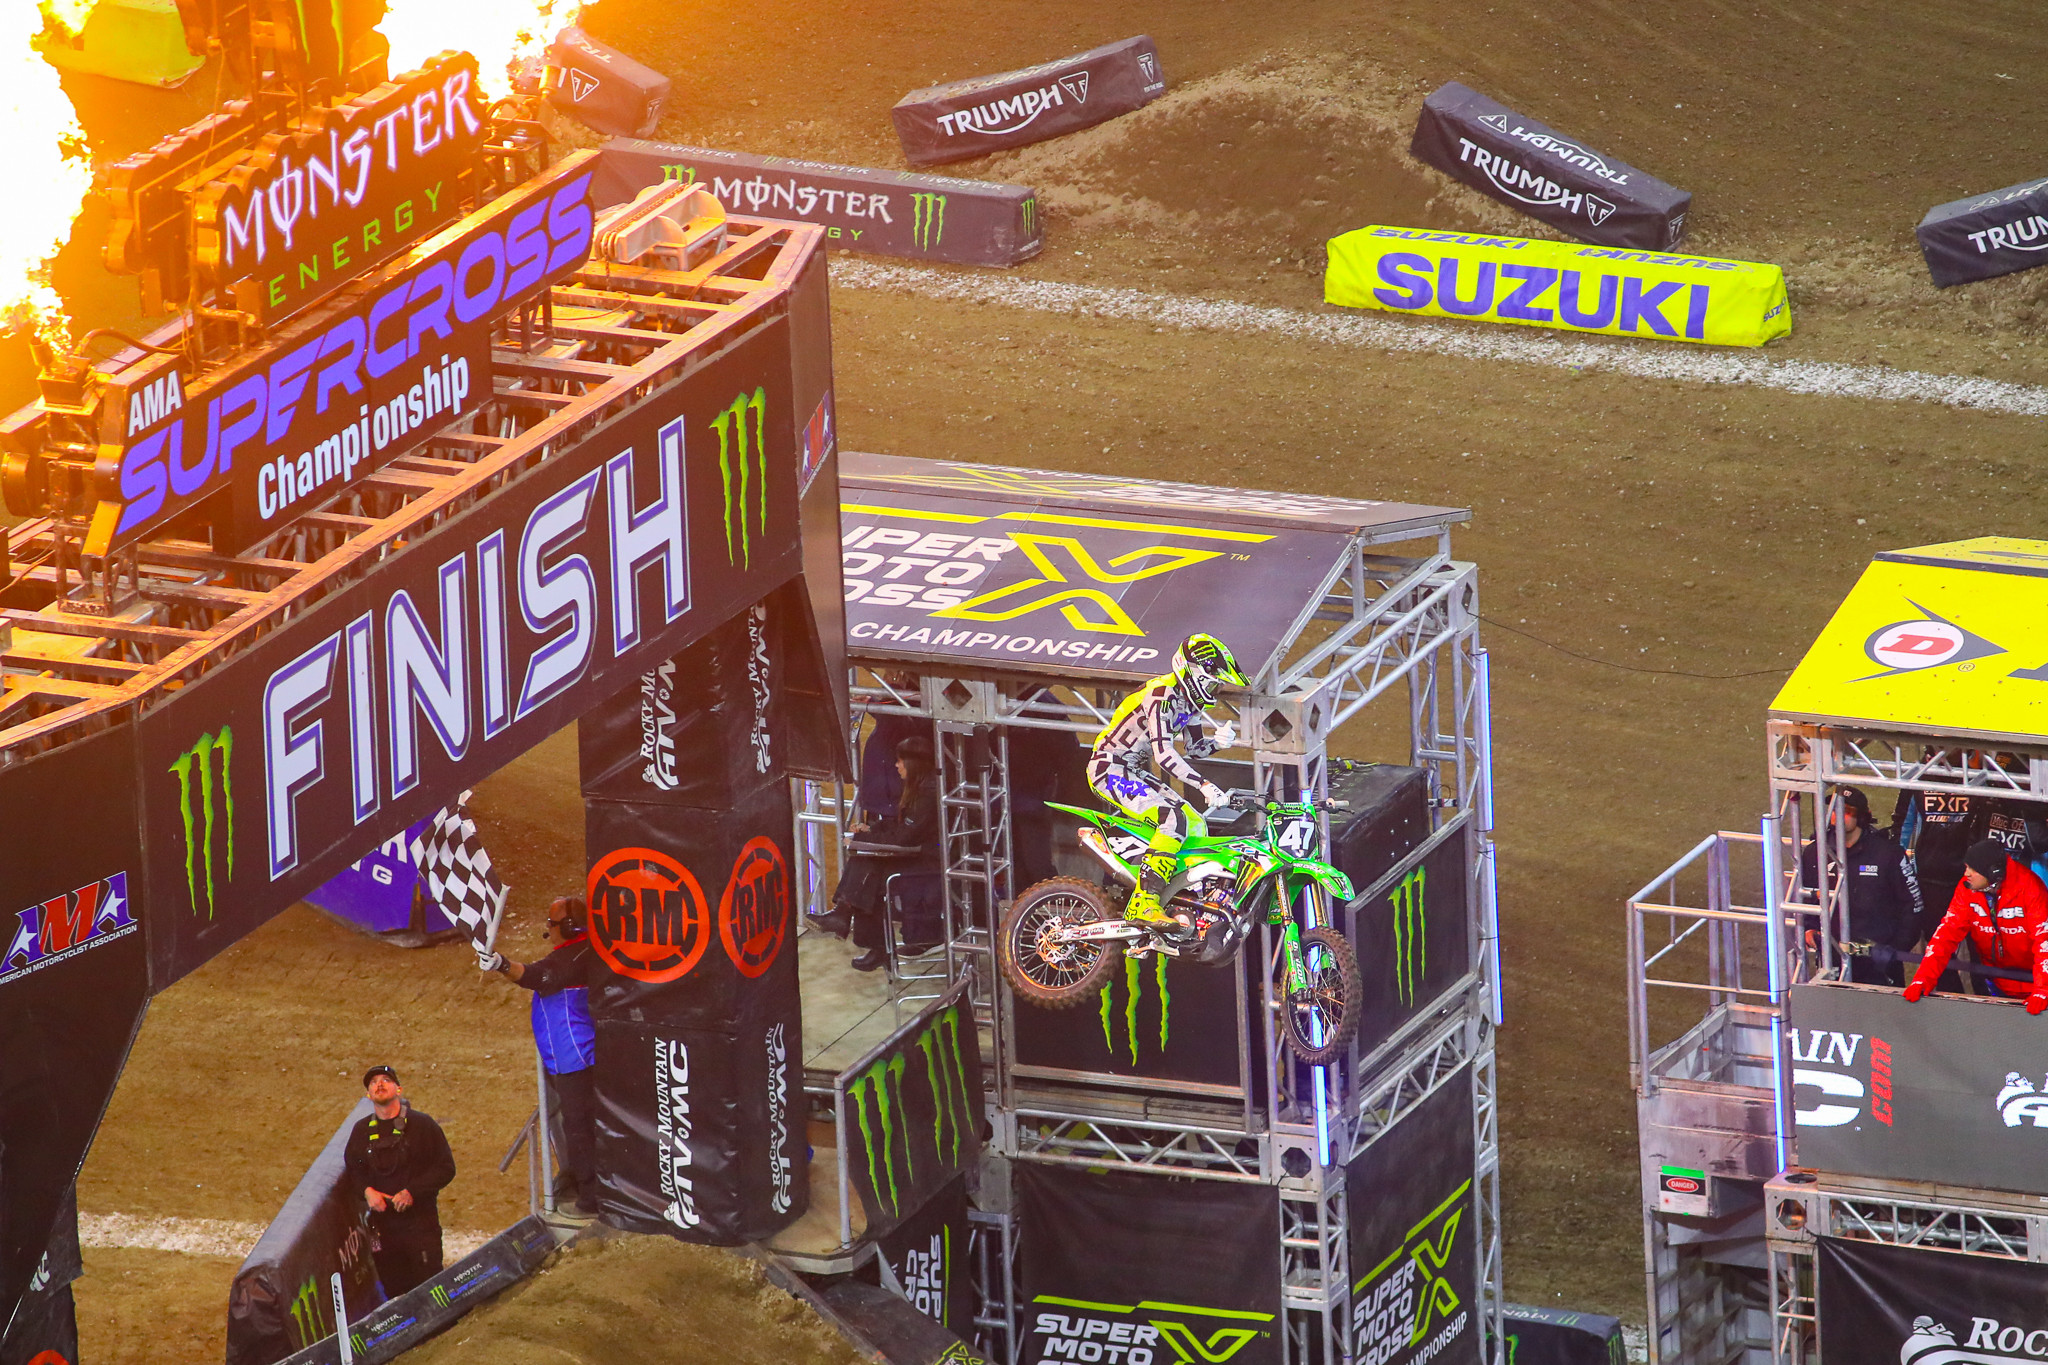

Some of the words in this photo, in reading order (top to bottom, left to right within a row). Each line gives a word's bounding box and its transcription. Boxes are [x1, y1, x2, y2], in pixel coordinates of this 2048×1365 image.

[937, 84, 1064, 137] TRIUMPH
[225, 68, 481, 269] MONSTER
[1459, 137, 1583, 214] TRIUMPH
[1510, 126, 1629, 185] TRIUMPH
[713, 175, 893, 224] MONSTER
[270, 181, 444, 308] ENERGY
[1369, 227, 1528, 250] SUZUKI
[1372, 252, 1710, 340] SUZUKI
[117, 171, 594, 536] SUPERCROSS
[128, 370, 182, 437] AMA
[258, 355, 470, 520] Championship
[262, 413, 692, 881] FINISH
[850, 620, 1160, 664] CHAMPIONSHIP
[1878, 633, 1955, 657] D
[640, 699, 656, 760] ROCKY
[1924, 796, 1970, 812] FXR
[1278, 821, 1315, 851] 47
[0, 870, 138, 975] AMA
[608, 885, 684, 947] RM
[32, 943, 89, 972] MOTORCYCLIST
[89, 925, 138, 949] ASSOCIATION
[655, 1037, 673, 1138] MOUNTAIN
[765, 1028, 777, 1123] MOUNTAIN
[658, 1138, 676, 1198] ROCKY
[769, 1129, 781, 1187] ROCKY
[1671, 1181, 1695, 1189] DANGER
[1353, 1258, 1417, 1332] SUPER
[1357, 1288, 1413, 1356] MOTO
[1033, 1313, 1160, 1346] SUPER
[1043, 1337, 1154, 1365] MOTO
[1405, 1311, 1467, 1365] AMPIONSHIP
[1963, 1316, 2048, 1356] ROC
